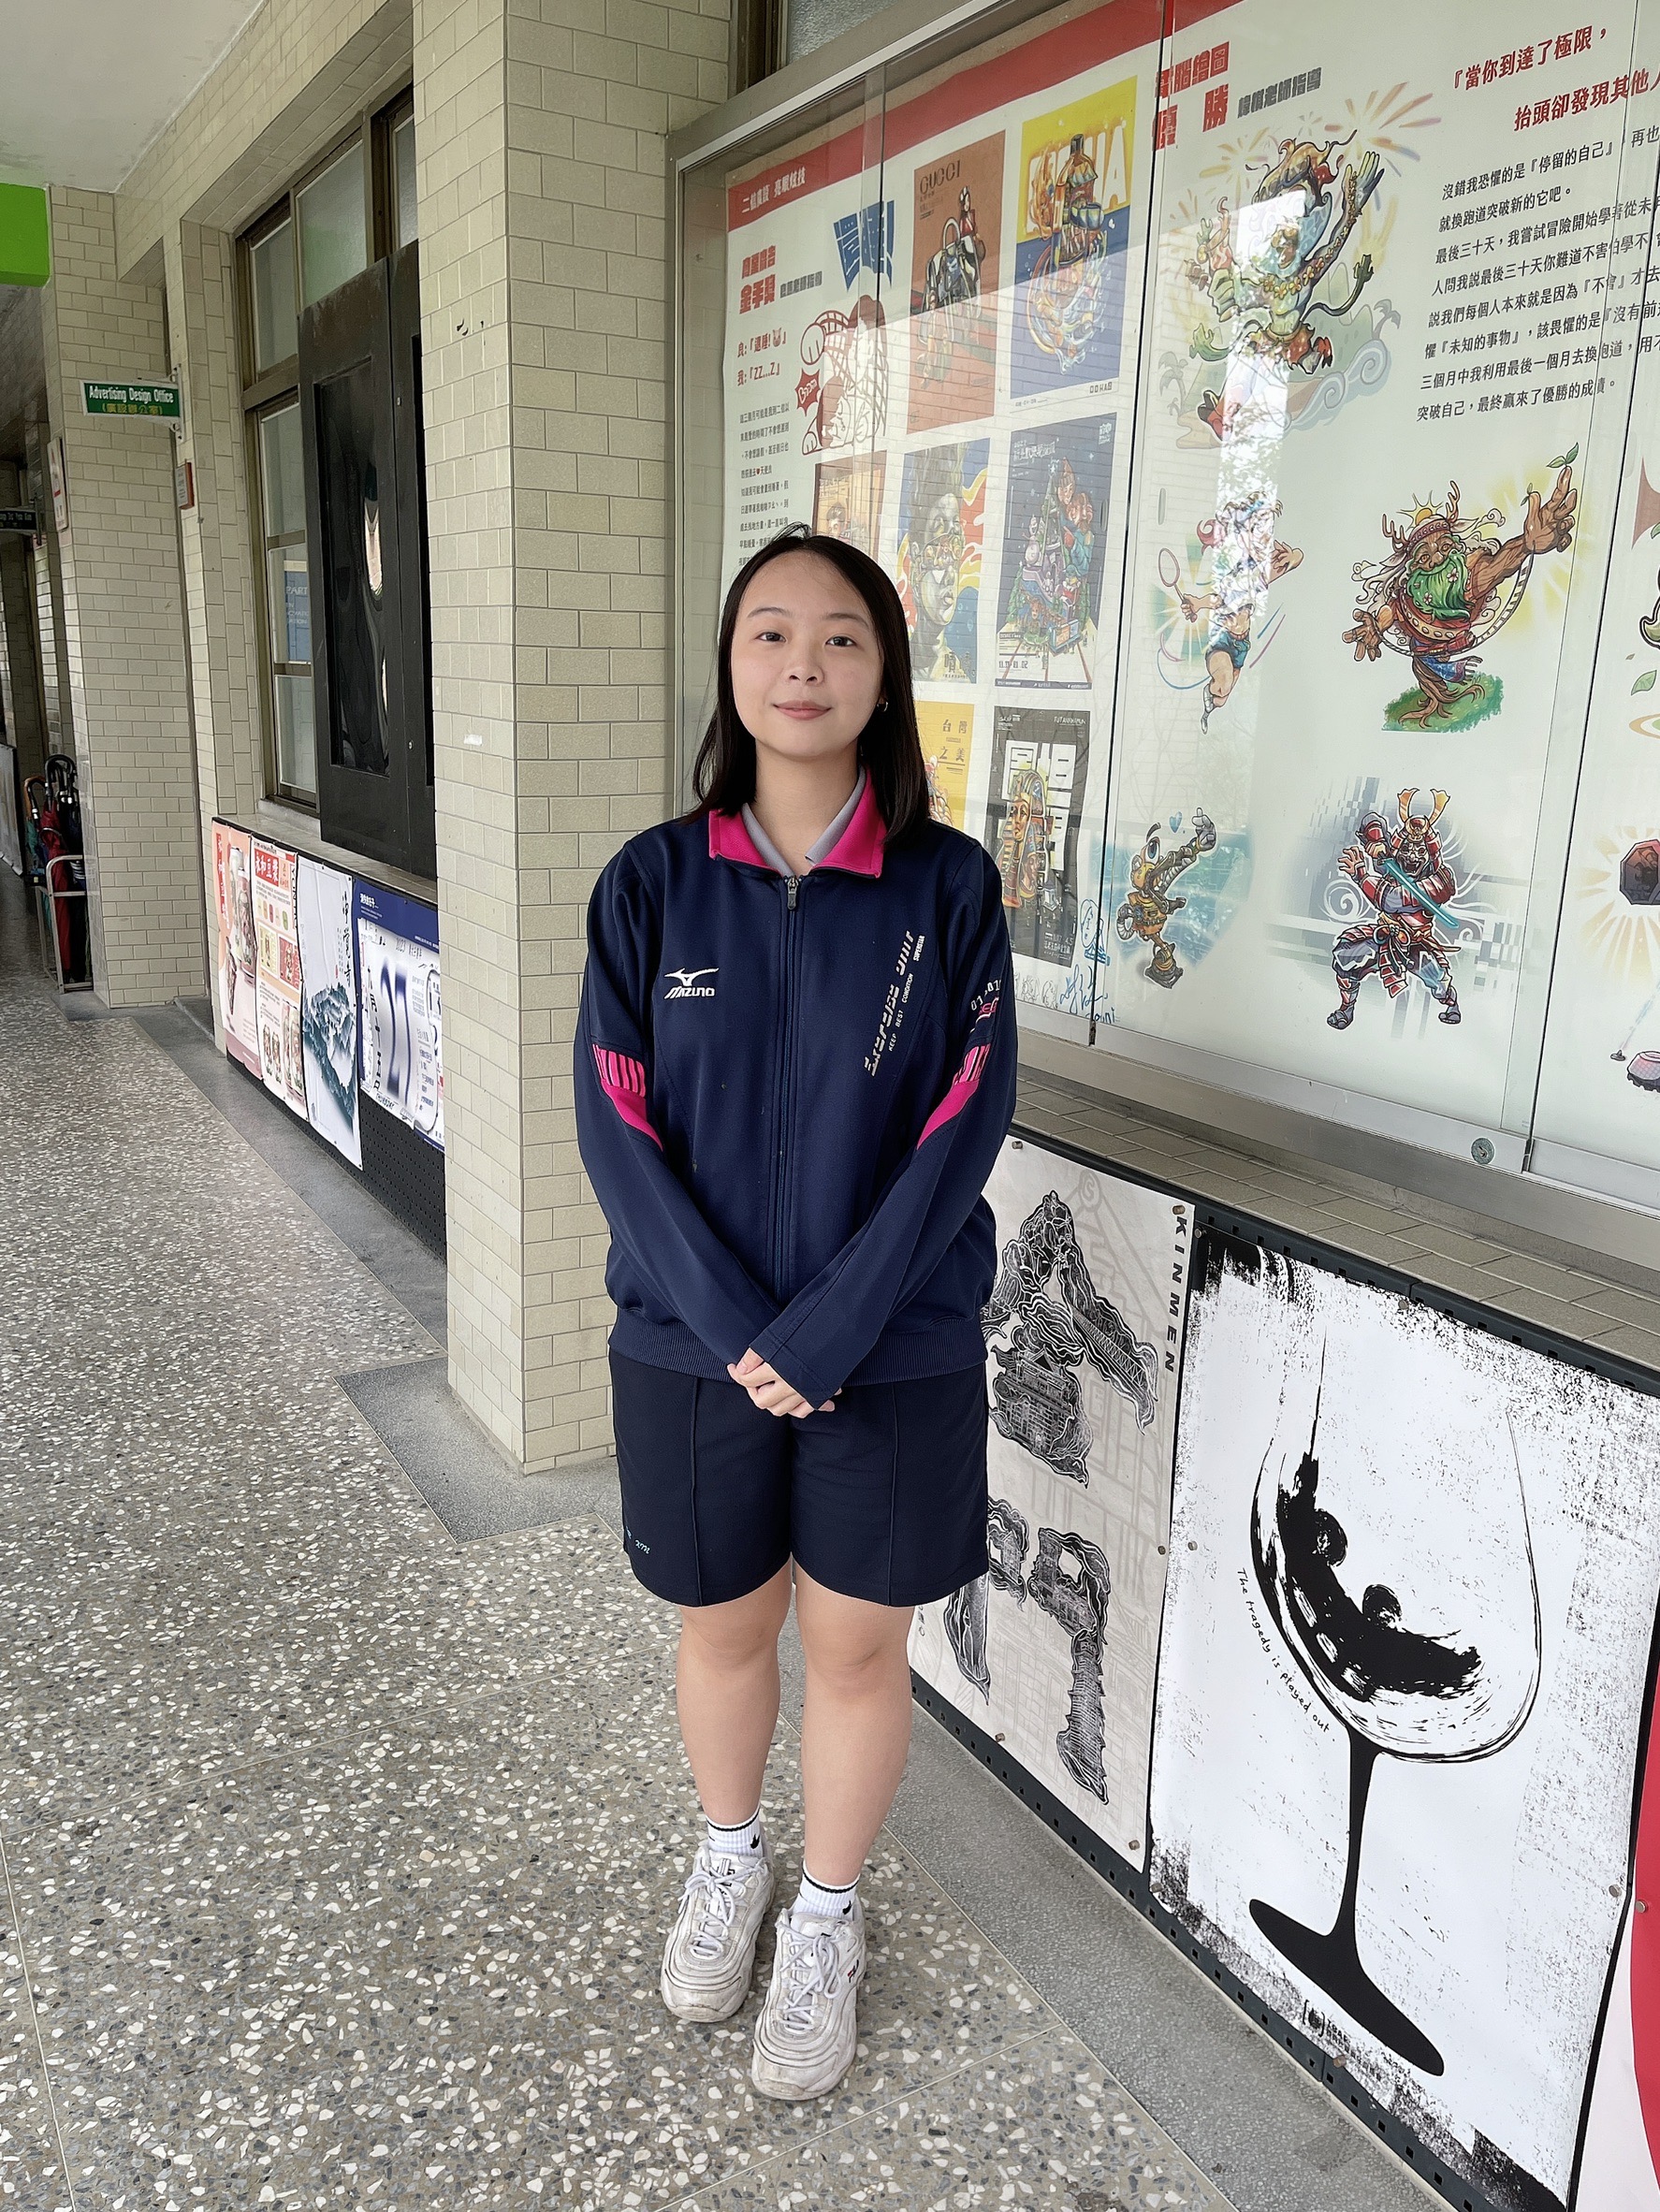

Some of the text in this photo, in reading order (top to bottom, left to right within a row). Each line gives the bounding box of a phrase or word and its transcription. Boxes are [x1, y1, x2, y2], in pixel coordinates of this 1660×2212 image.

[920, 160, 960, 195] GUCCI
[1435, 195, 1660, 265] 最後三十天，我嘗試冒險開始學著從未
[1424, 299, 1660, 359] 懼『未知的事物』，該畏懼的是『沒有前
[89, 385, 174, 404] Advertising Design Office
[663, 985, 716, 999] MIZUNO
[888, 1032, 898, 1052] KEEP
[895, 1009, 904, 1028] BEST
[901, 972, 914, 1004] CONDITION
[1164, 1215, 1187, 1373] KINMEN
[1237, 1567, 1330, 1733] The tragedy is played out
